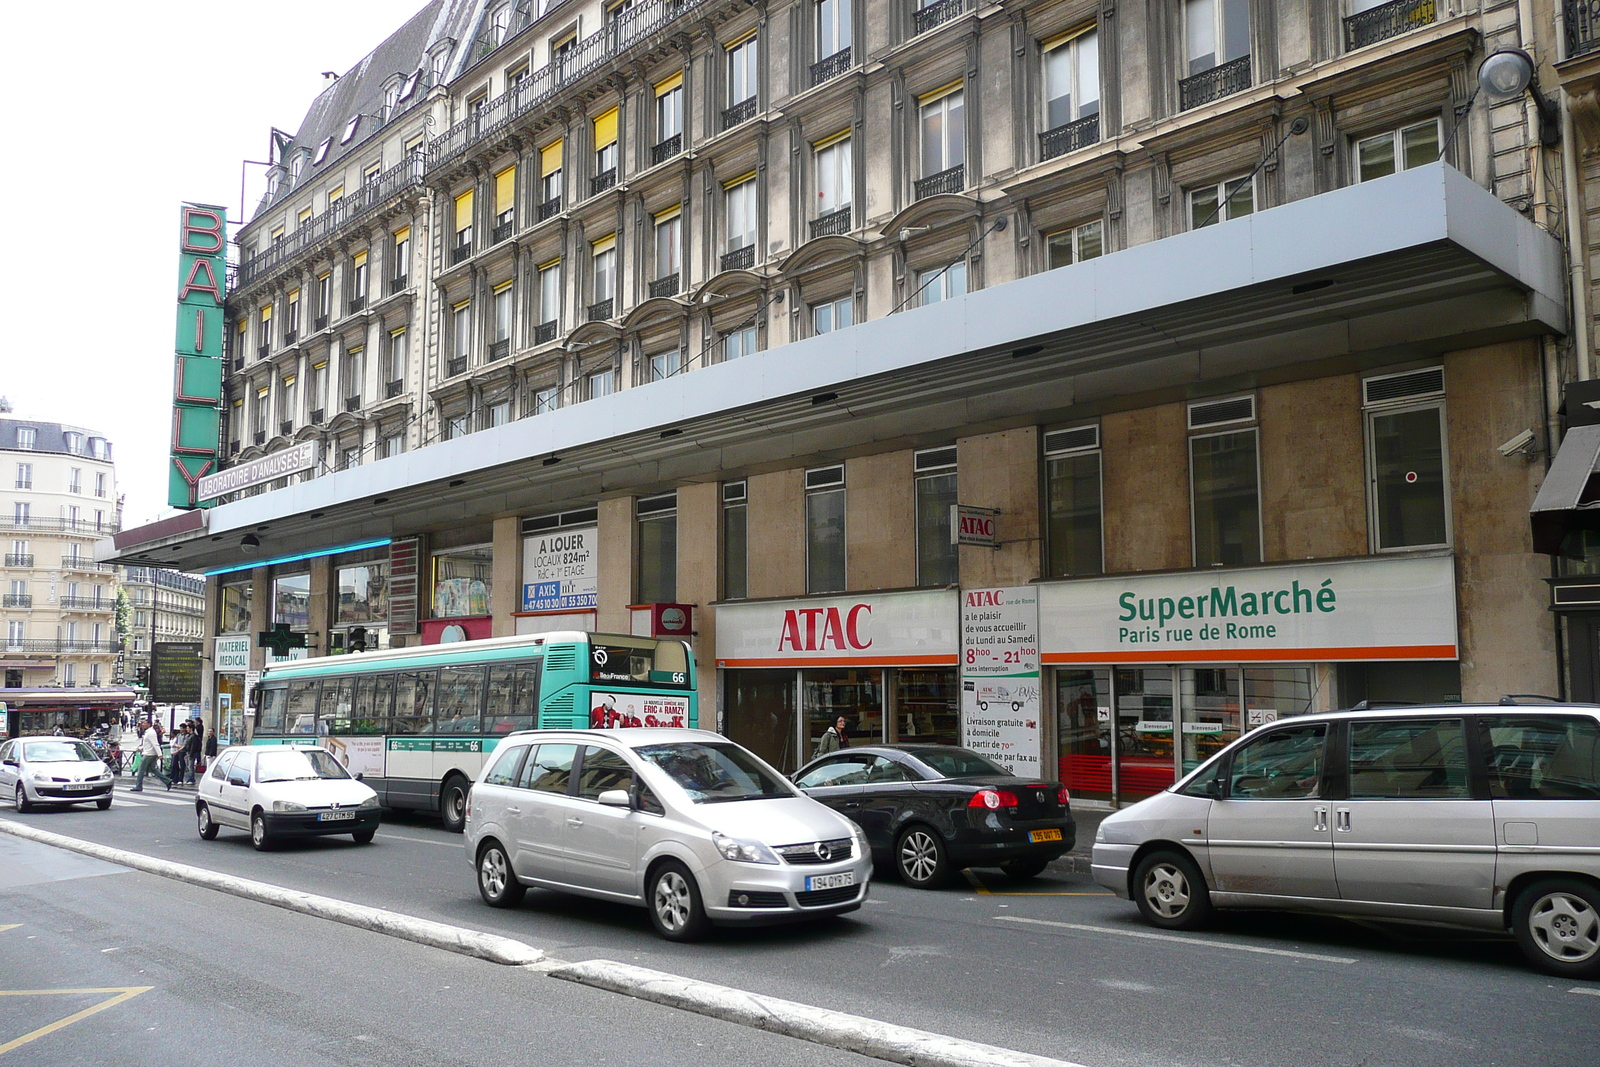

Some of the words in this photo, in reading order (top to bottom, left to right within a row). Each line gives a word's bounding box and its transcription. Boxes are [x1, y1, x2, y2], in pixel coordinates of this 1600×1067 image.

[174, 207, 224, 504] BAILLY
[200, 467, 249, 496] LABORATOIRE
[252, 450, 299, 479] D'ANALYSES
[960, 516, 994, 536] ATAC
[539, 540, 547, 554] A
[550, 534, 584, 553] LOUER
[534, 554, 562, 568] LOCAUX
[564, 565, 585, 577] ETAGE
[539, 584, 556, 597] AXIS
[965, 590, 1004, 607] ATAC
[1118, 578, 1336, 628] SuperMarché
[971, 612, 978, 621] le
[979, 611, 1002, 622] plaisir
[777, 604, 873, 652] ATAC
[965, 624, 974, 633] de
[993, 622, 1026, 632] accueillir
[1119, 626, 1160, 643] Paris
[1166, 628, 1193, 642] rue
[1199, 623, 1220, 640] de
[1226, 623, 1276, 639] Rome
[965, 636, 975, 645] du
[976, 635, 996, 644] Lundi
[1007, 634, 1036, 644] Samedi
[218, 641, 248, 652] MATERIEL
[219, 655, 246, 666] MEDICAL
[978, 665, 1009, 673] interruption
[672, 672, 685, 683] 66
[643, 705, 658, 713] ERIC
[664, 706, 685, 715] RAMZY
[966, 717, 996, 726] Livraison
[997, 719, 1023, 727] gratuite
[972, 728, 1000, 737] domicile
[391, 741, 398, 749] 66
[470, 741, 478, 751] 66
[972, 739, 991, 748] partir
[991, 740, 1000, 748] de
[978, 752, 1003, 760] mande
[1004, 754, 1016, 762] par
[1016, 753, 1028, 762] fax
